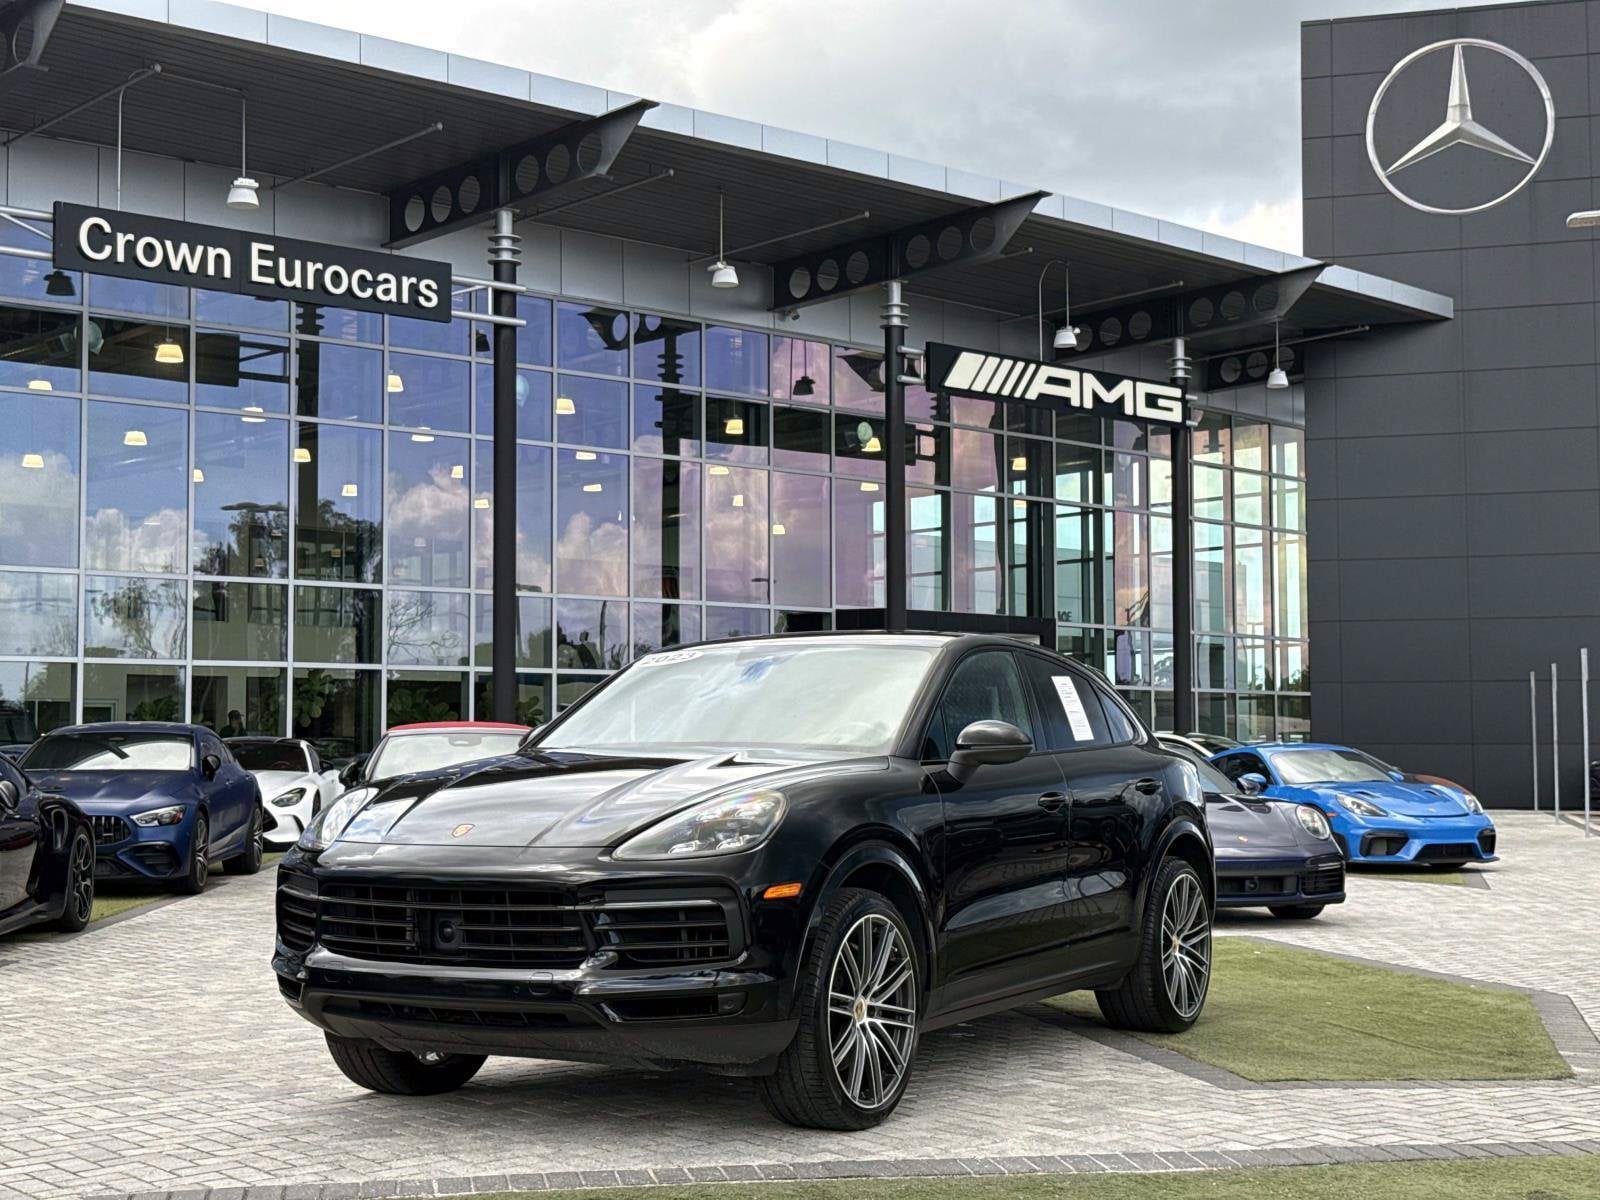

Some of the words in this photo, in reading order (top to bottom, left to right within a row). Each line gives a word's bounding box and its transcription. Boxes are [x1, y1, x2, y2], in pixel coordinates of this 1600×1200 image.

[79, 217, 231, 278] Crown
[251, 242, 439, 308] Eurocars
[1025, 365, 1182, 423] AMG
